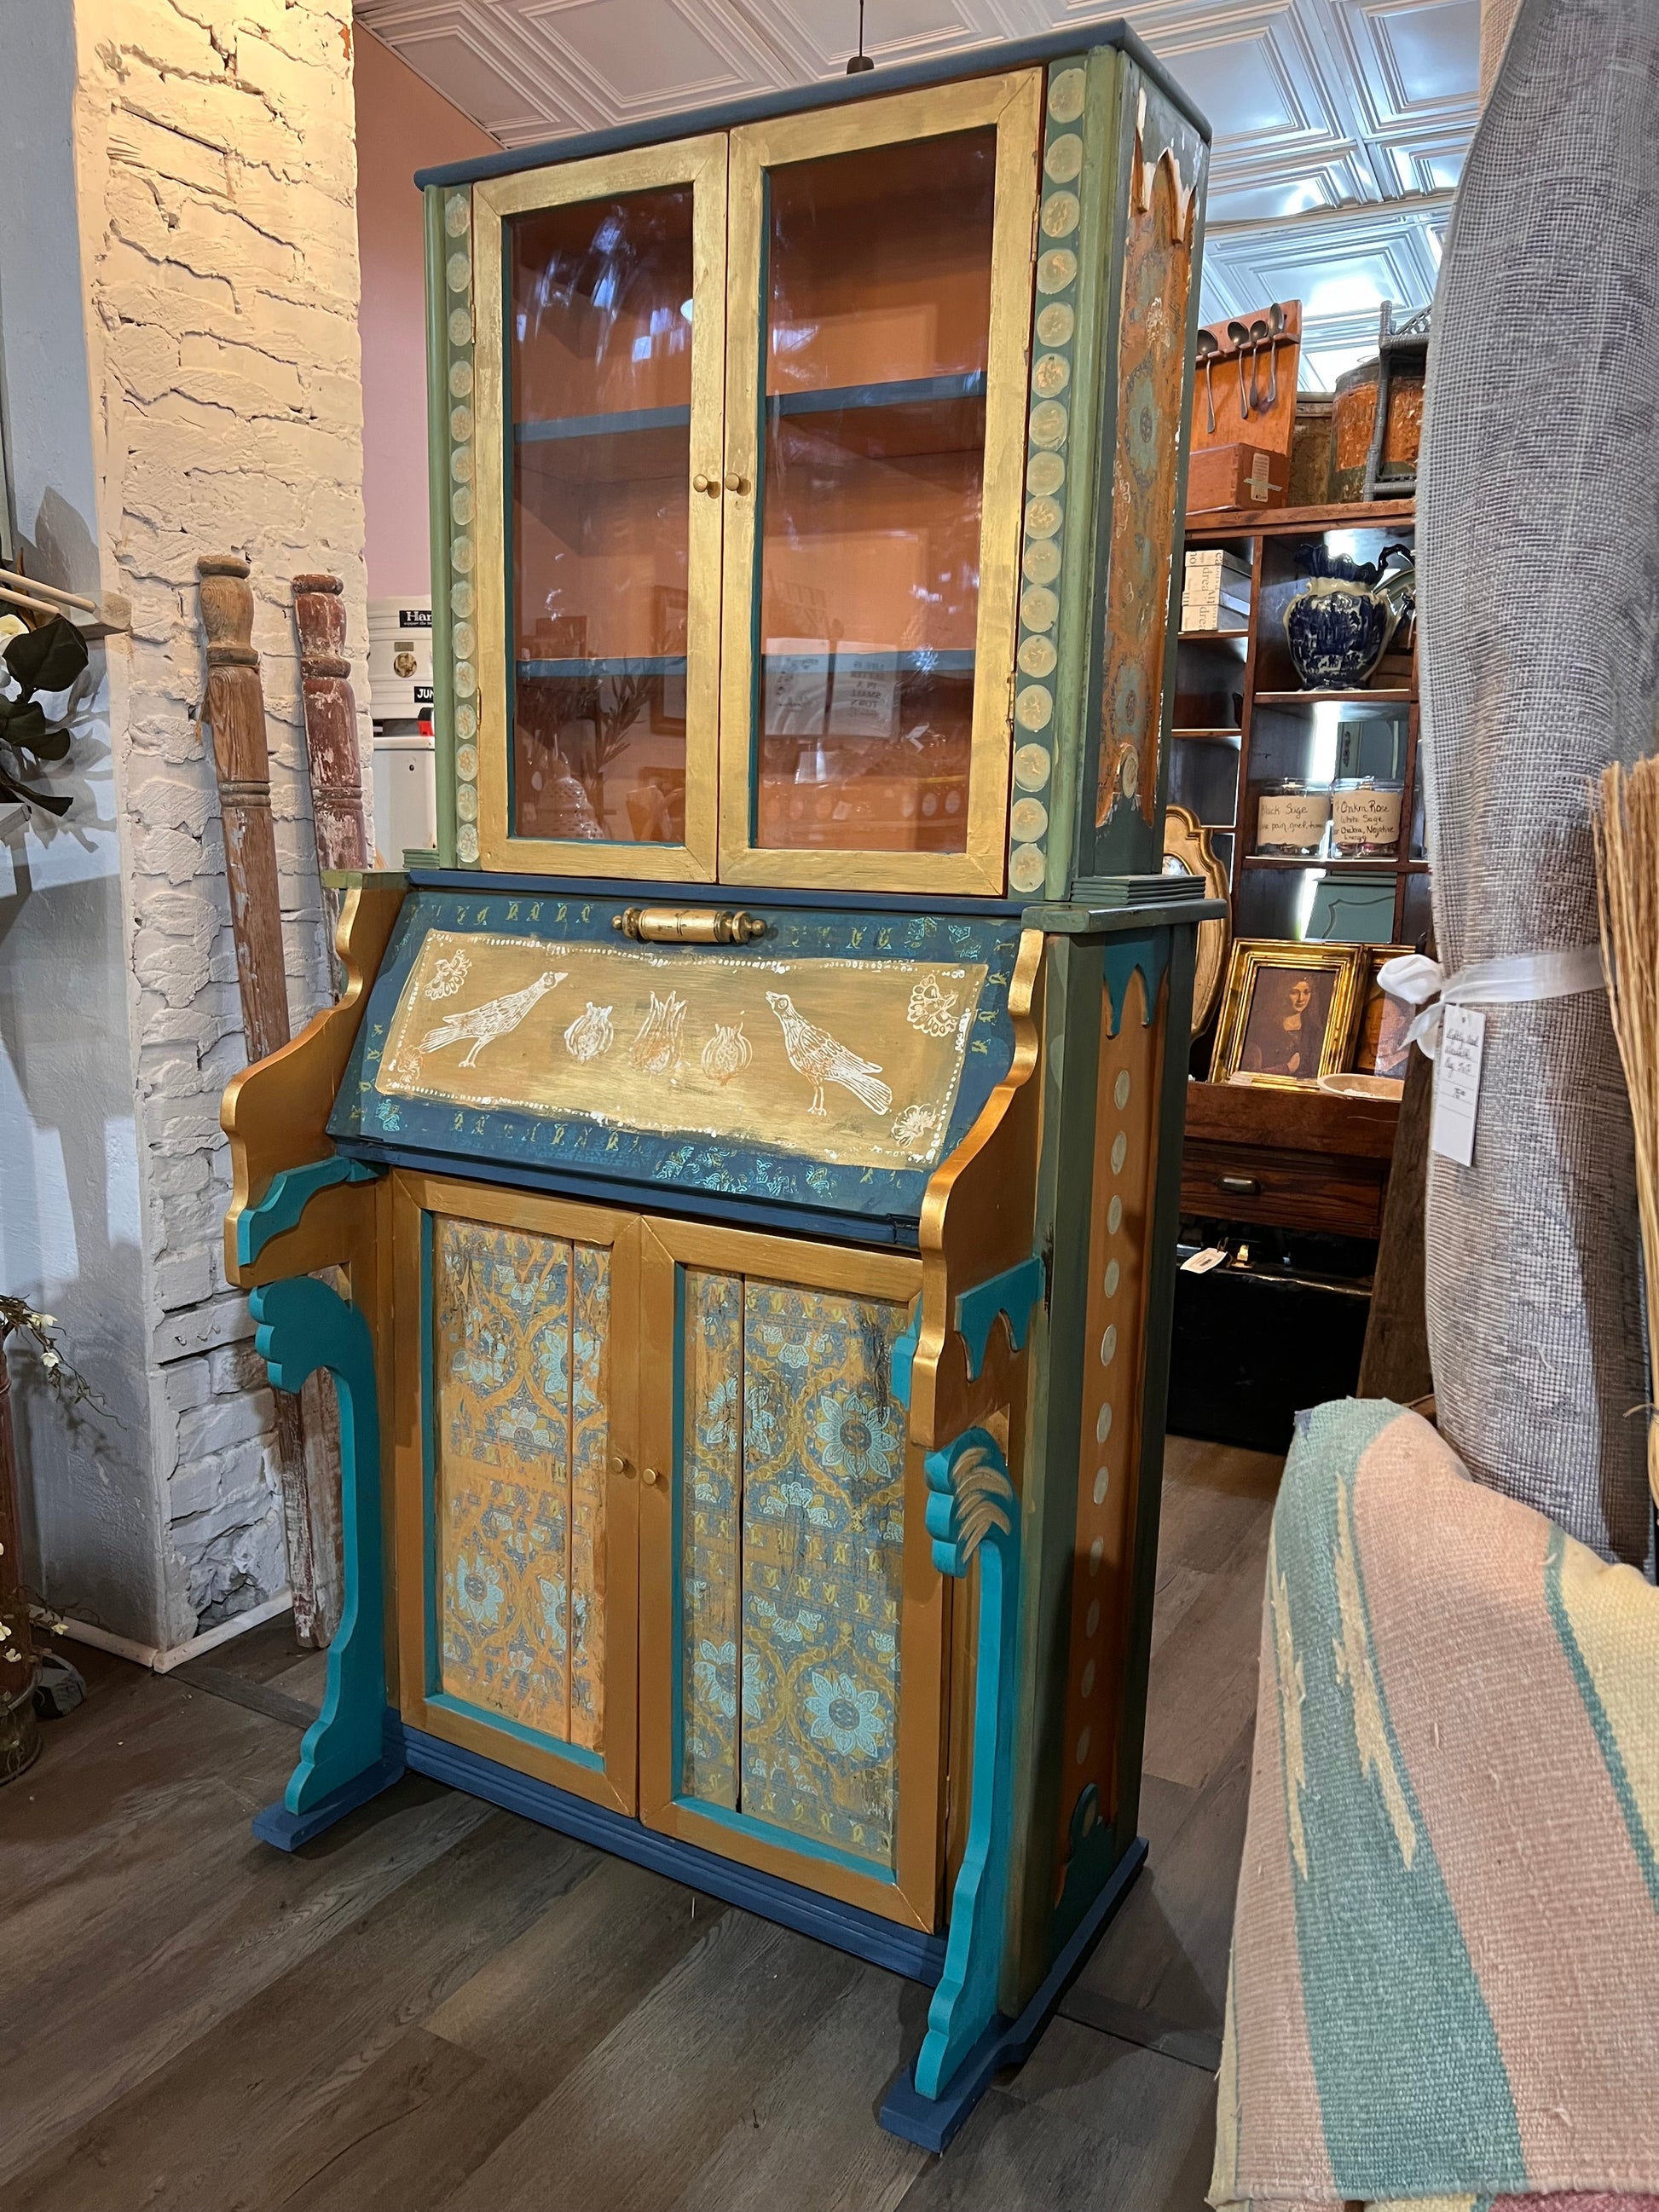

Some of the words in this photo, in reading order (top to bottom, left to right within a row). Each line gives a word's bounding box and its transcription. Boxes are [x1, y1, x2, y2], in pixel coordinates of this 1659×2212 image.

[1286, 803, 1308, 819] Sage
[1363, 814, 1383, 825] Sage
[1367, 825, 1394, 838] Negative
